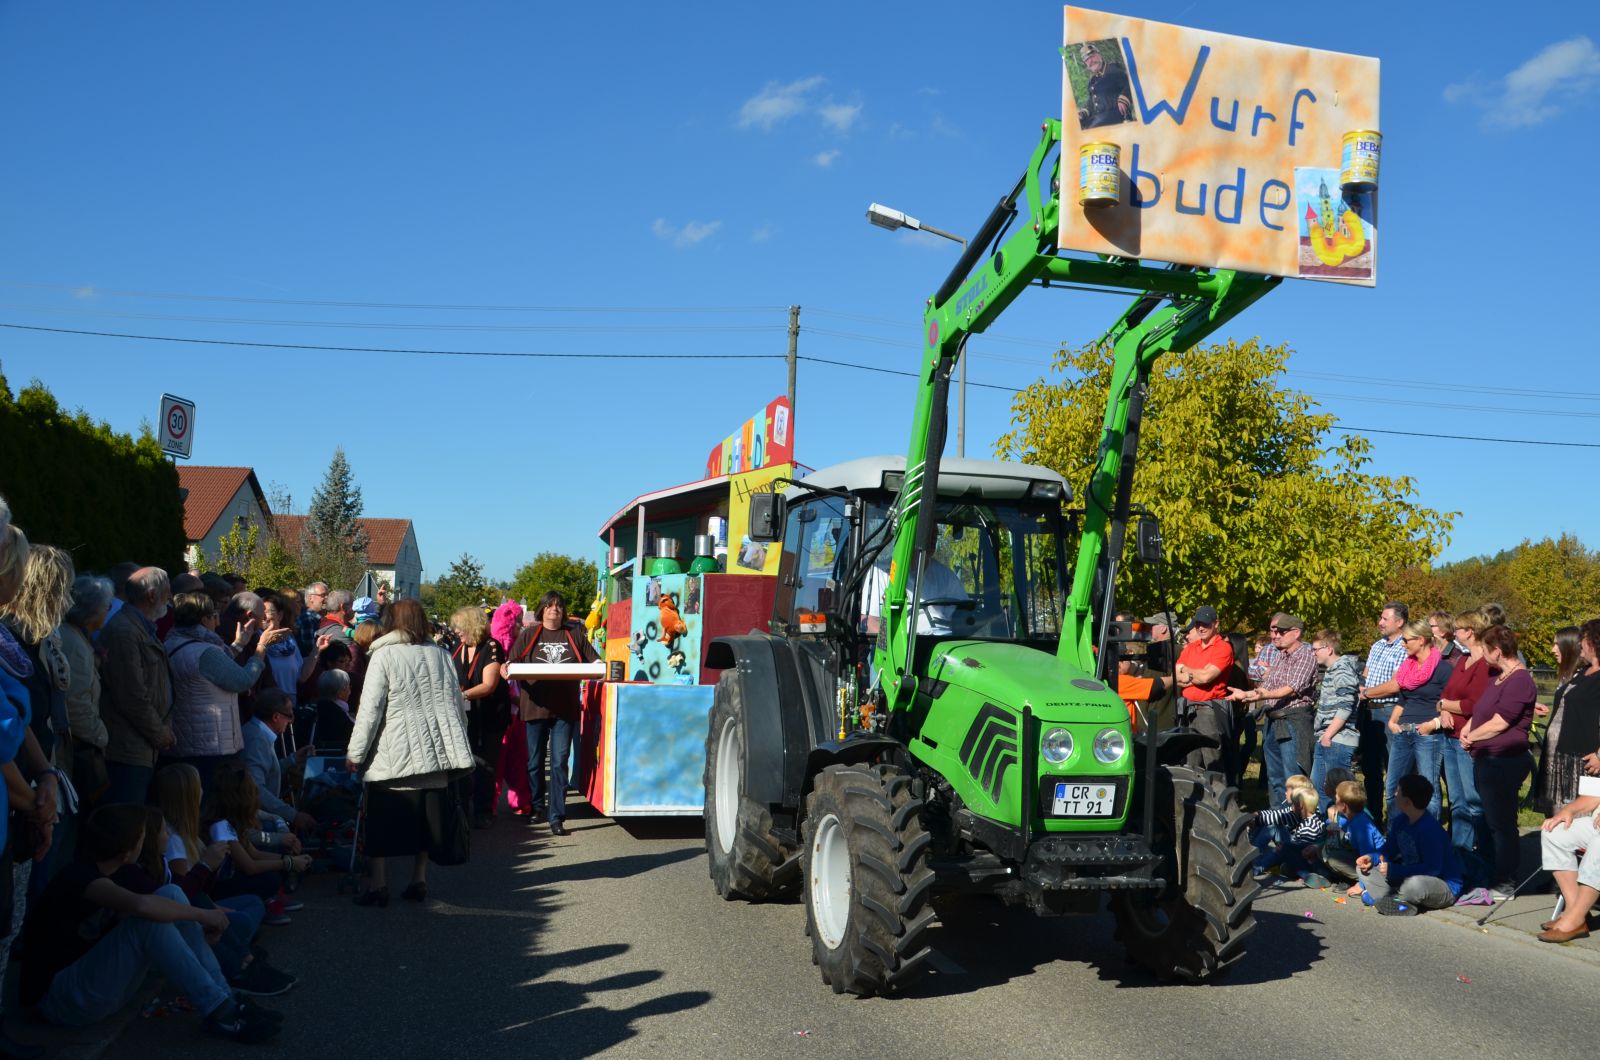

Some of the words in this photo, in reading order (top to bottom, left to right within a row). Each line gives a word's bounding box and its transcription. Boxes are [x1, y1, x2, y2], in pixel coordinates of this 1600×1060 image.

[1121, 36, 1317, 147] Wurf
[1130, 143, 1291, 232] bude
[171, 413, 184, 430] 30
[167, 439, 183, 451] ZONE
[1071, 786, 1090, 800] CR
[1063, 801, 1080, 814] TT
[1086, 801, 1102, 814] 91
